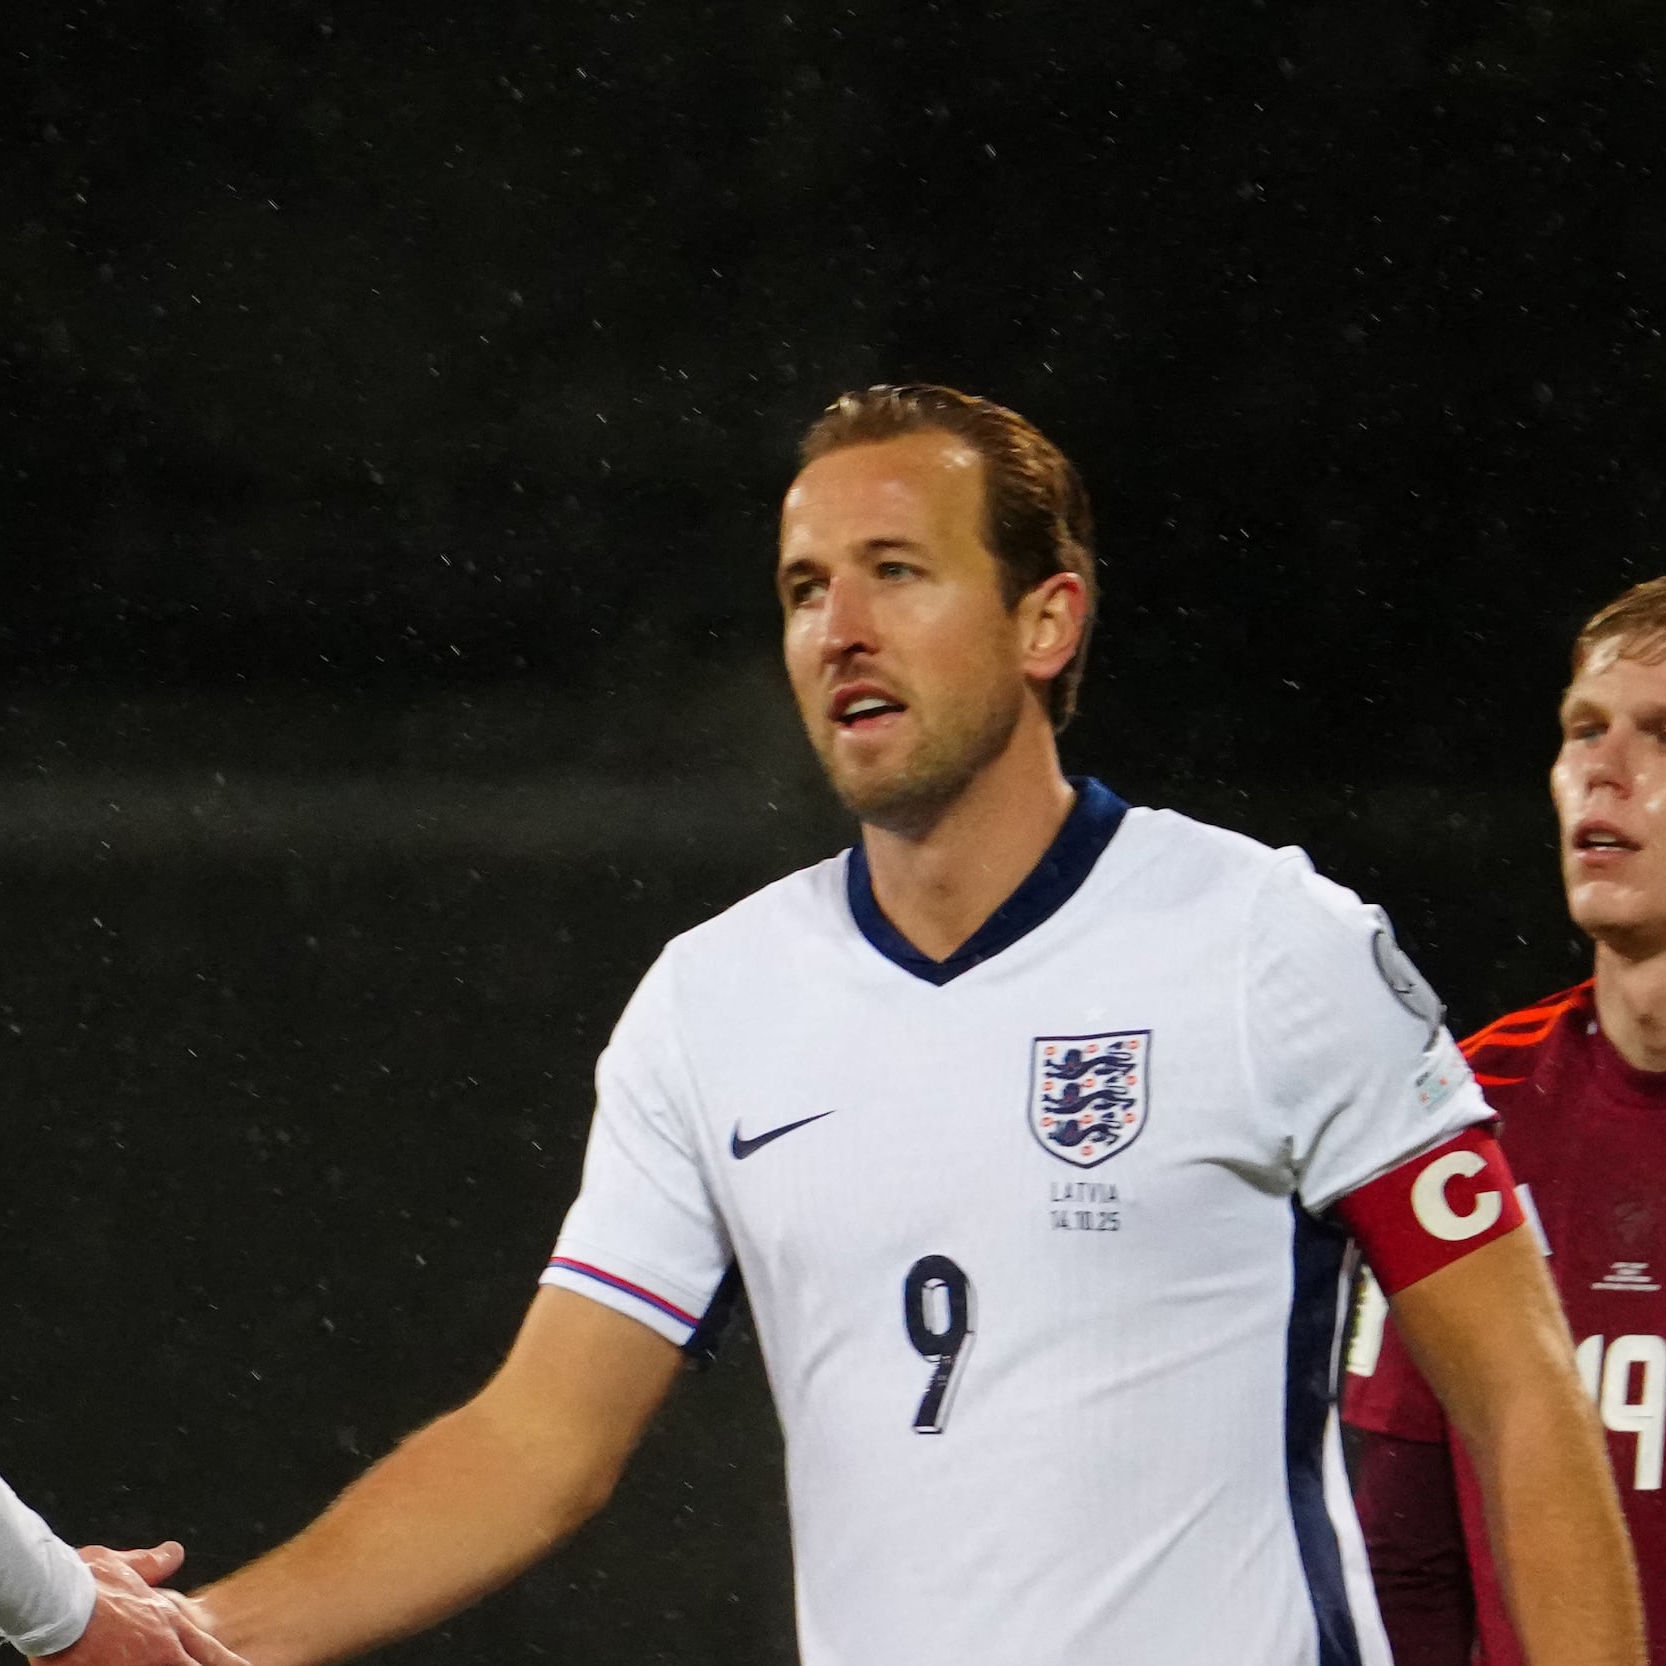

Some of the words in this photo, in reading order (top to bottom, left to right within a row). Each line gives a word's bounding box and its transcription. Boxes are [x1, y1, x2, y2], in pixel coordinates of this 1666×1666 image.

[1049, 1209, 1122, 1232] 14.10.25
[1050, 1181, 1120, 1203] LATVIA
[1411, 1150, 1502, 1241] C
[904, 1254, 978, 1434] 9
